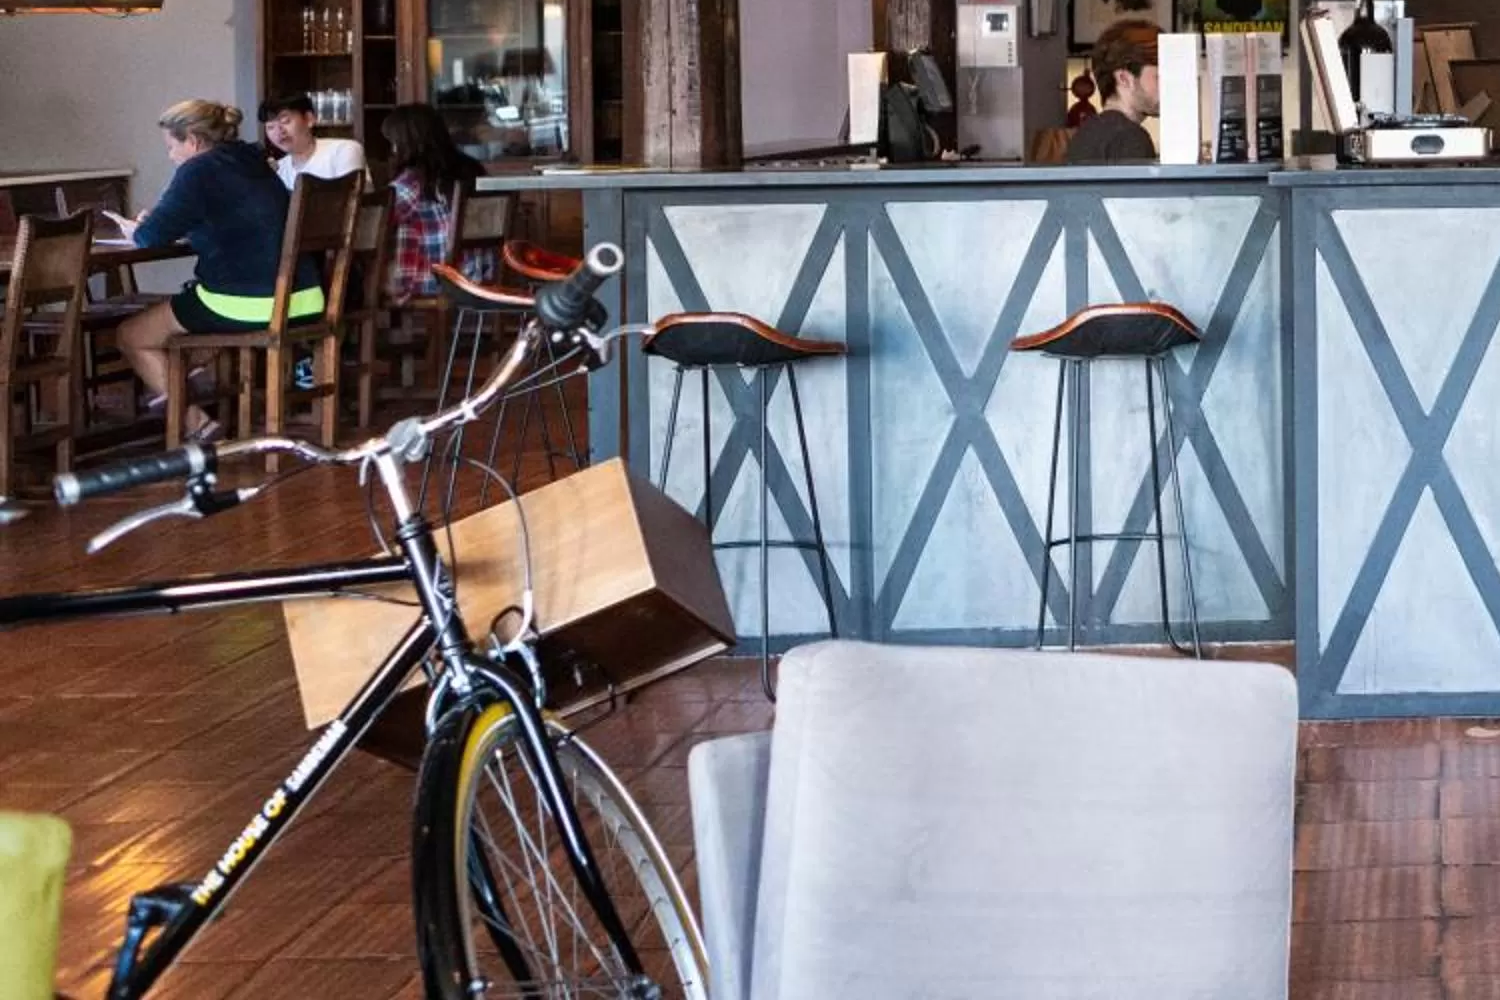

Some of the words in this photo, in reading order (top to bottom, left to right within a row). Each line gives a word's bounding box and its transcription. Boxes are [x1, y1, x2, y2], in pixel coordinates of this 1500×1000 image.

[1204, 21, 1284, 36] SANDEMAN
[190, 868, 225, 905] THE
[217, 813, 270, 875] HOUSE
[263, 787, 286, 819] OF
